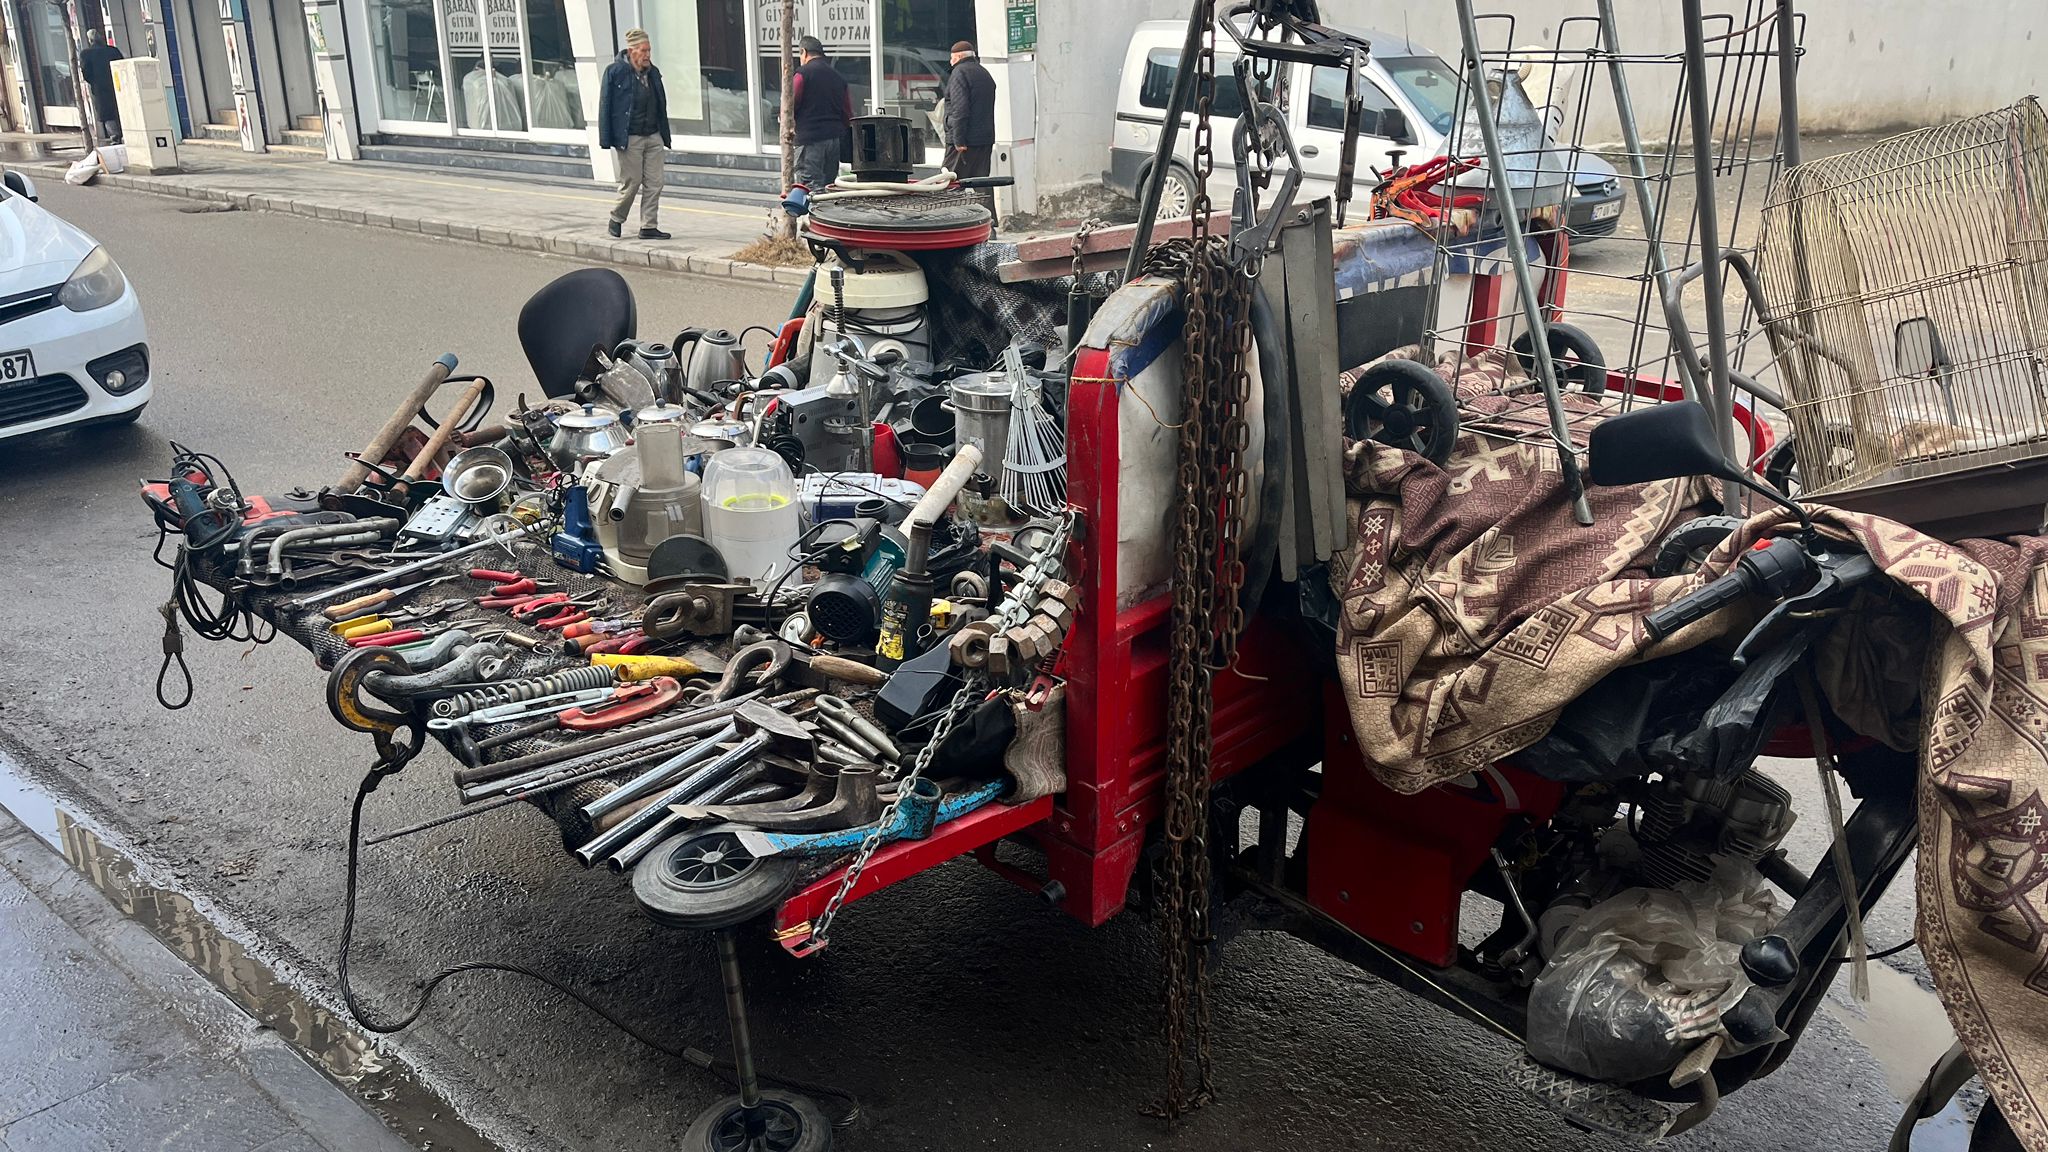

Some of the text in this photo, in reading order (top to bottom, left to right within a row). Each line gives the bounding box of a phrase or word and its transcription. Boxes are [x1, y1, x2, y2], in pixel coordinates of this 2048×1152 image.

[829, 4, 864, 21] GİYİM
[452, 15, 474, 28] GİYİM
[493, 15, 517, 28] GİYİM
[450, 32, 479, 43] TOPTAN
[824, 26, 870, 40] TOPTAN
[0, 356, 28, 380] 87
